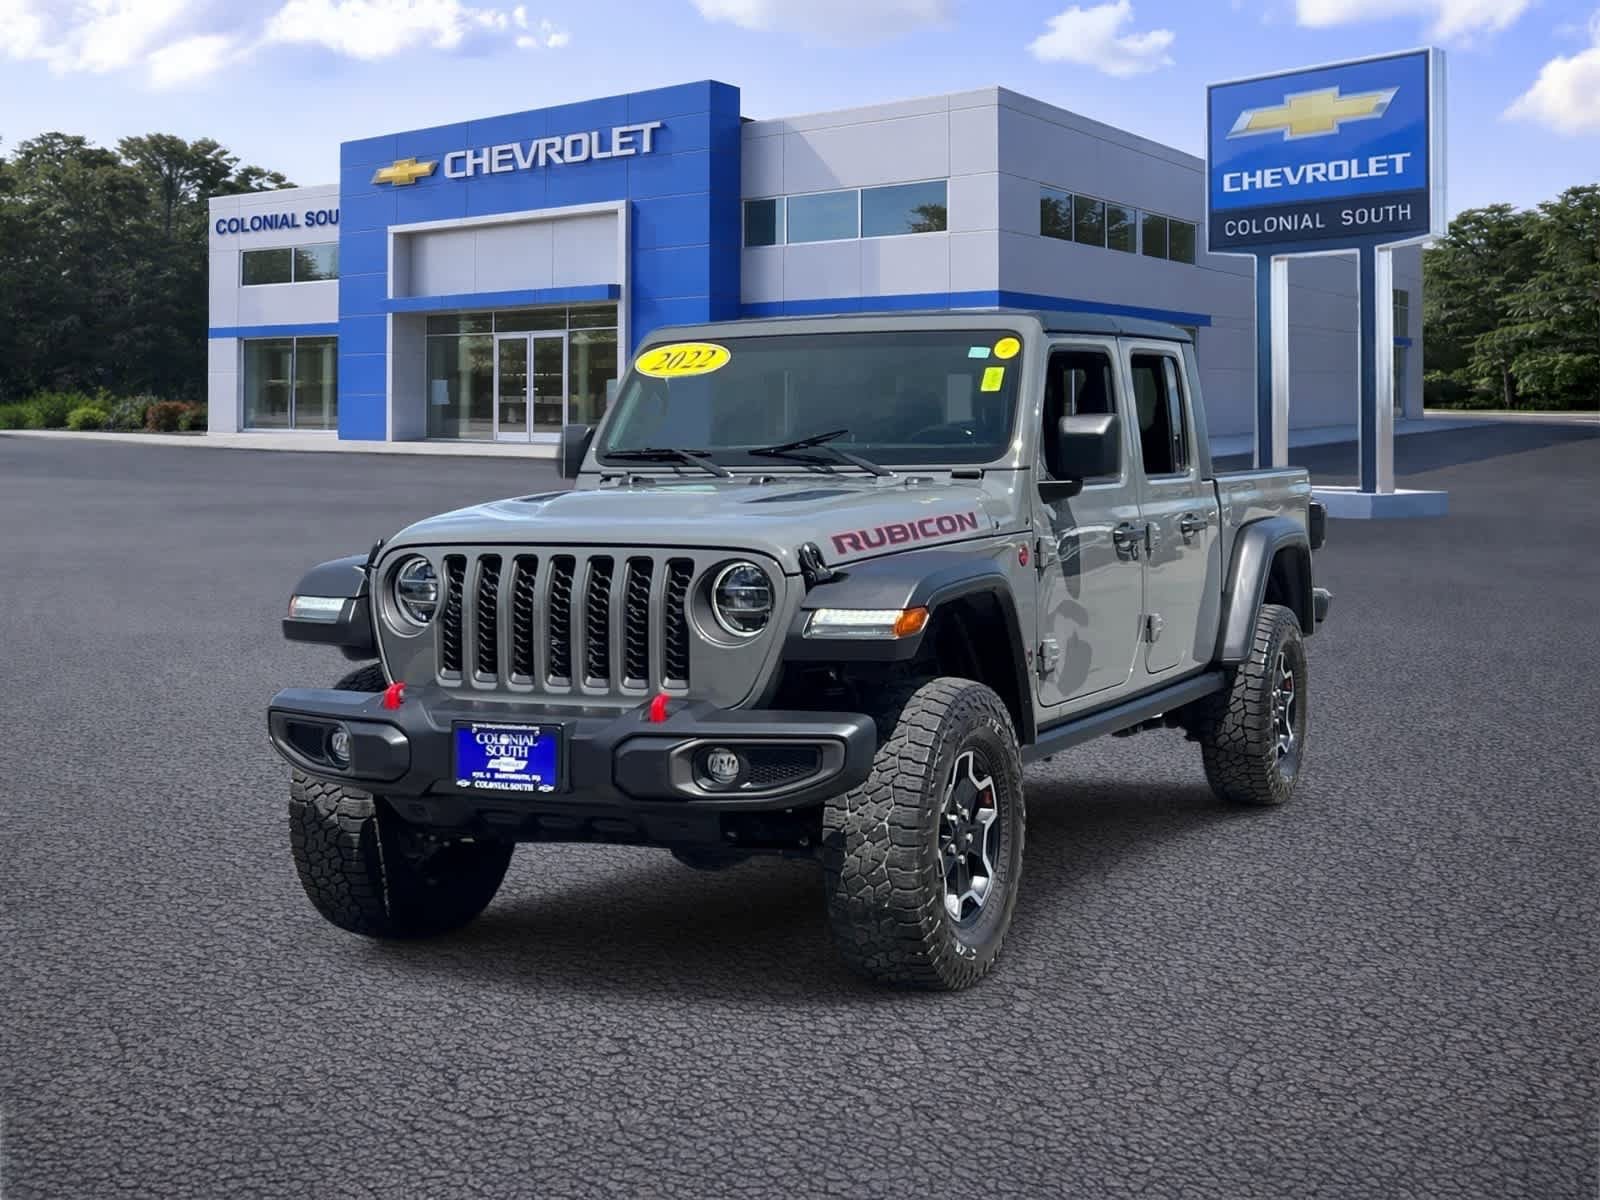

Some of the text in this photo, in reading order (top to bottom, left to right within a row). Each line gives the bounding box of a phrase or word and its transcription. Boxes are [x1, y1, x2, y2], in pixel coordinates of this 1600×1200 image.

[443, 121, 662, 180] CHEVROLET
[1222, 152, 1412, 193] CHEVROLET
[215, 213, 301, 235] COLONIAL
[1224, 203, 1412, 237] COLONIAL SOUTH
[650, 349, 717, 371] 2022
[831, 511, 978, 555] RUBICON
[476, 732, 538, 746] COLONIAL
[485, 745, 528, 757] SOUTH
